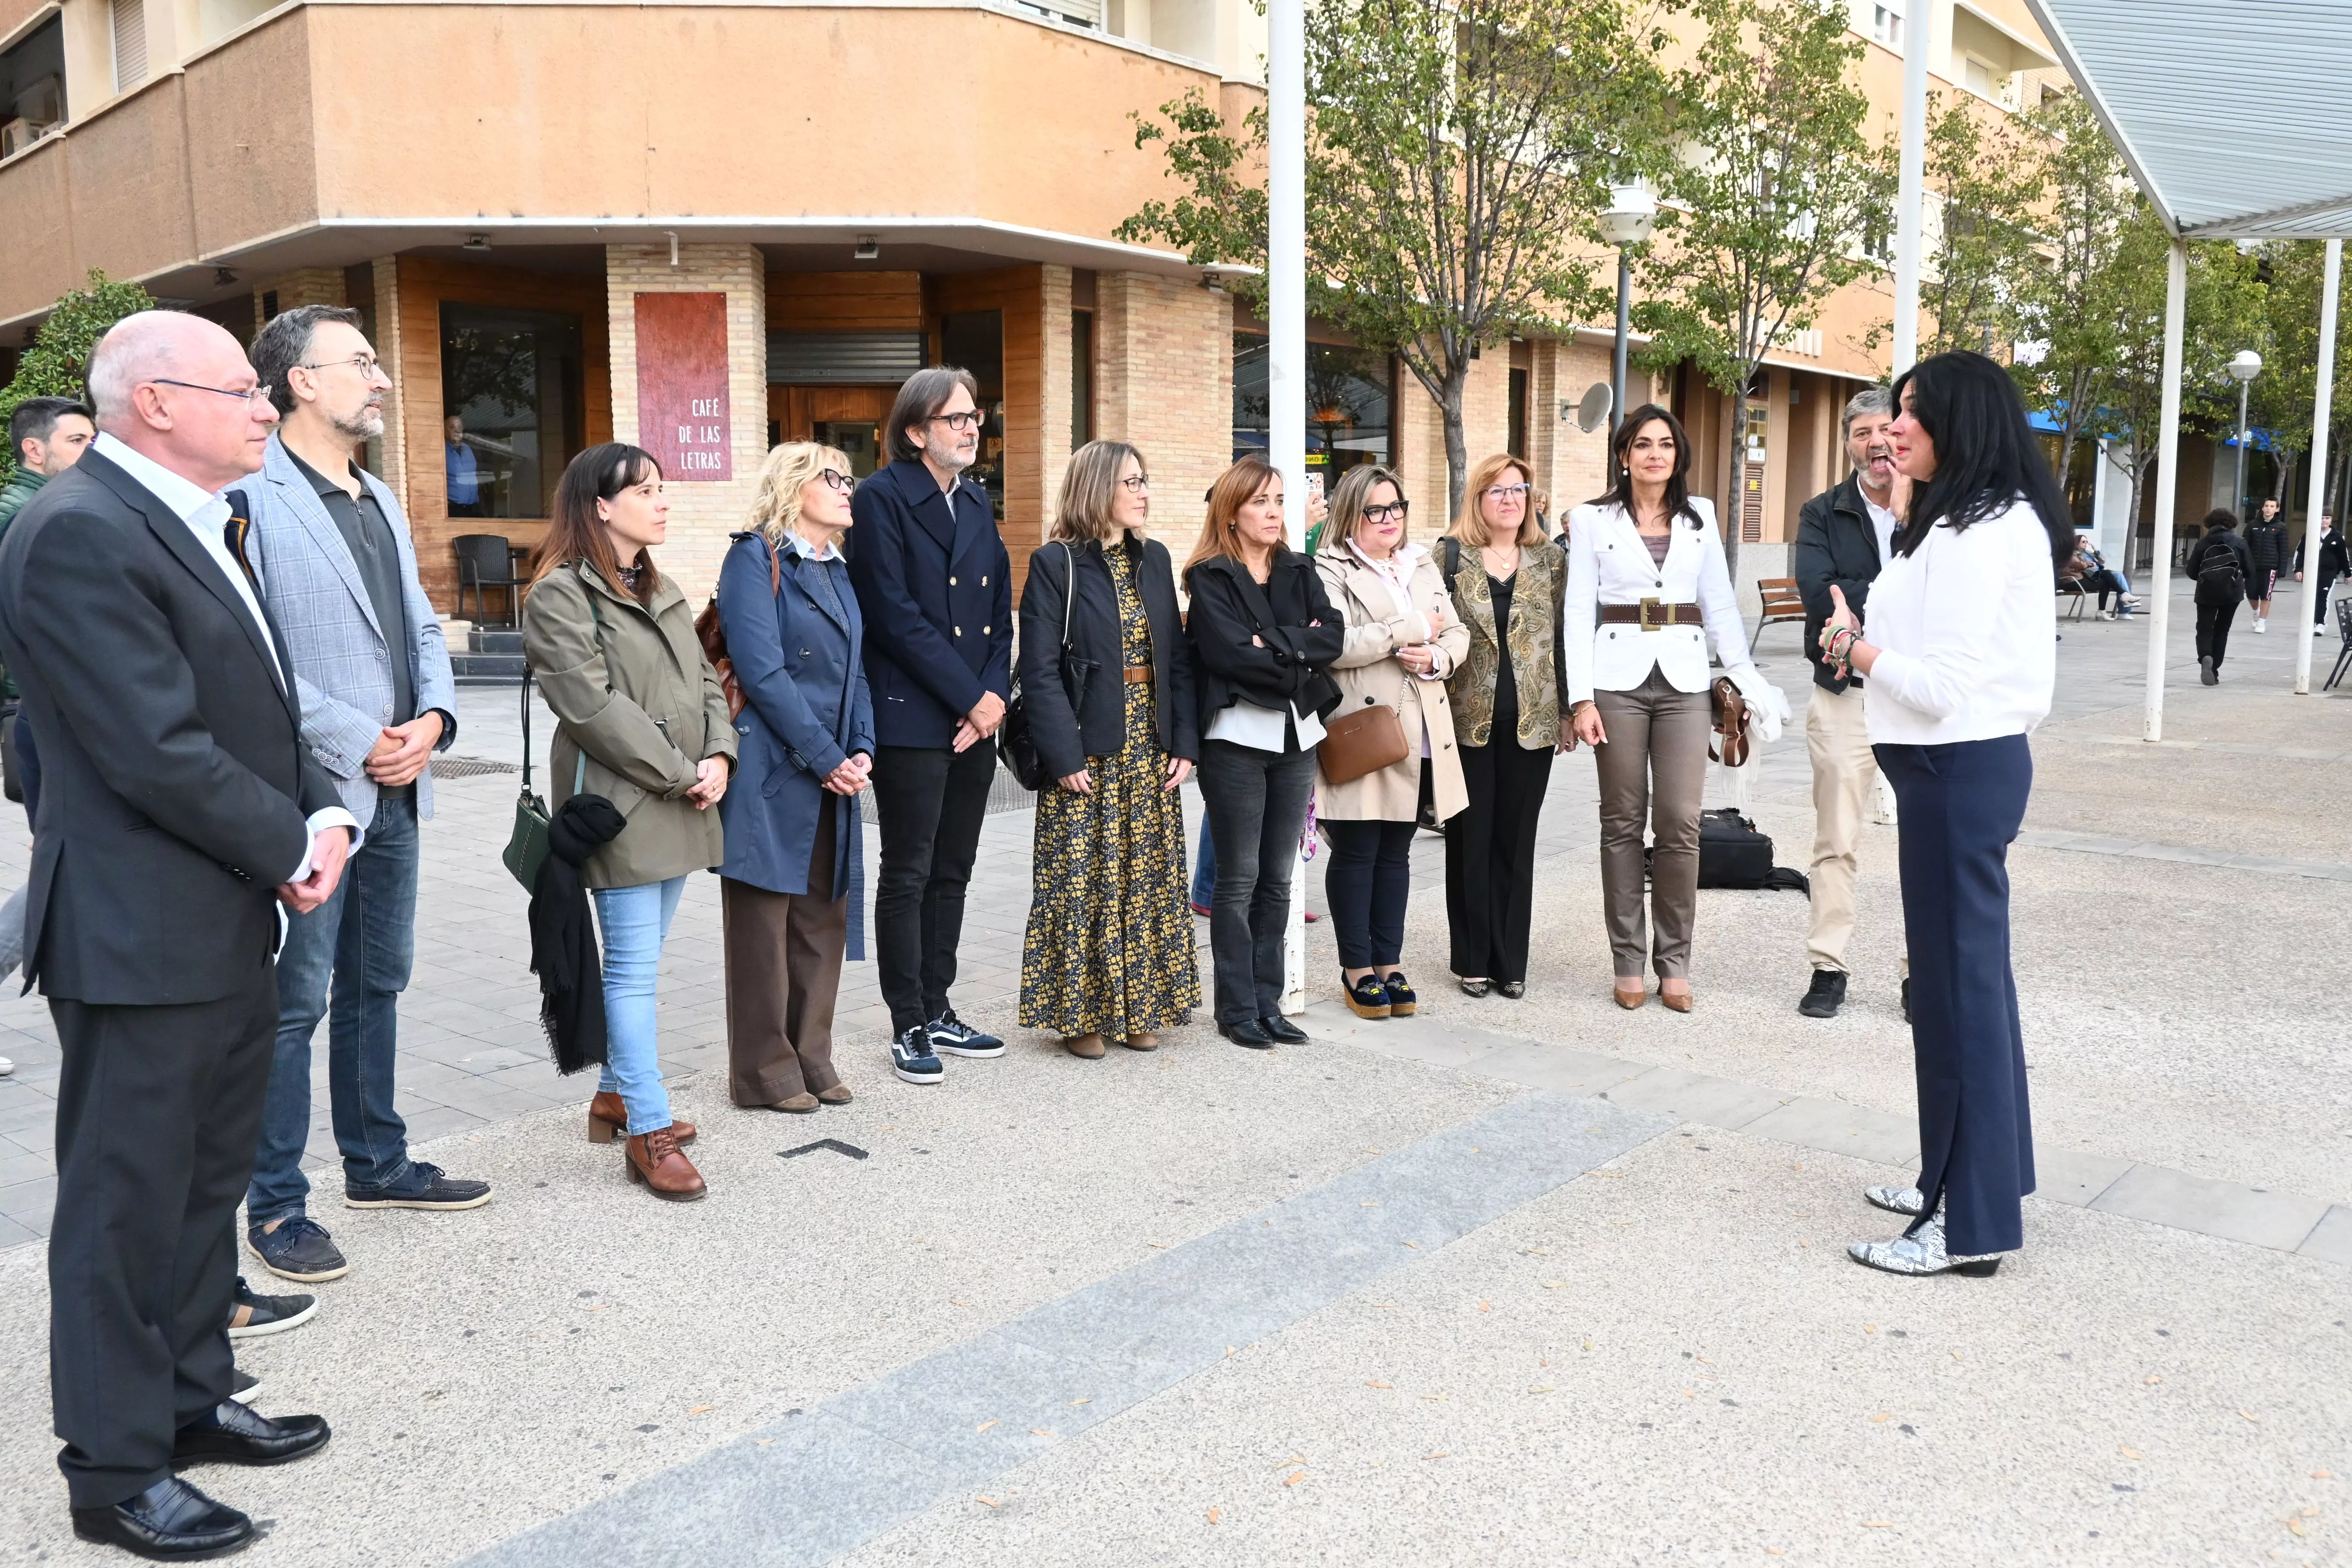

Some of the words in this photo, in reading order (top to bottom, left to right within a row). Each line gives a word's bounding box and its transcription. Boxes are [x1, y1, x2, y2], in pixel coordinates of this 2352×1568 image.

[692, 397, 719, 417] CAFÉ
[679, 425, 692, 443] DE
[700, 425, 720, 443] LAS
[681, 452, 721, 469] LETRAS
